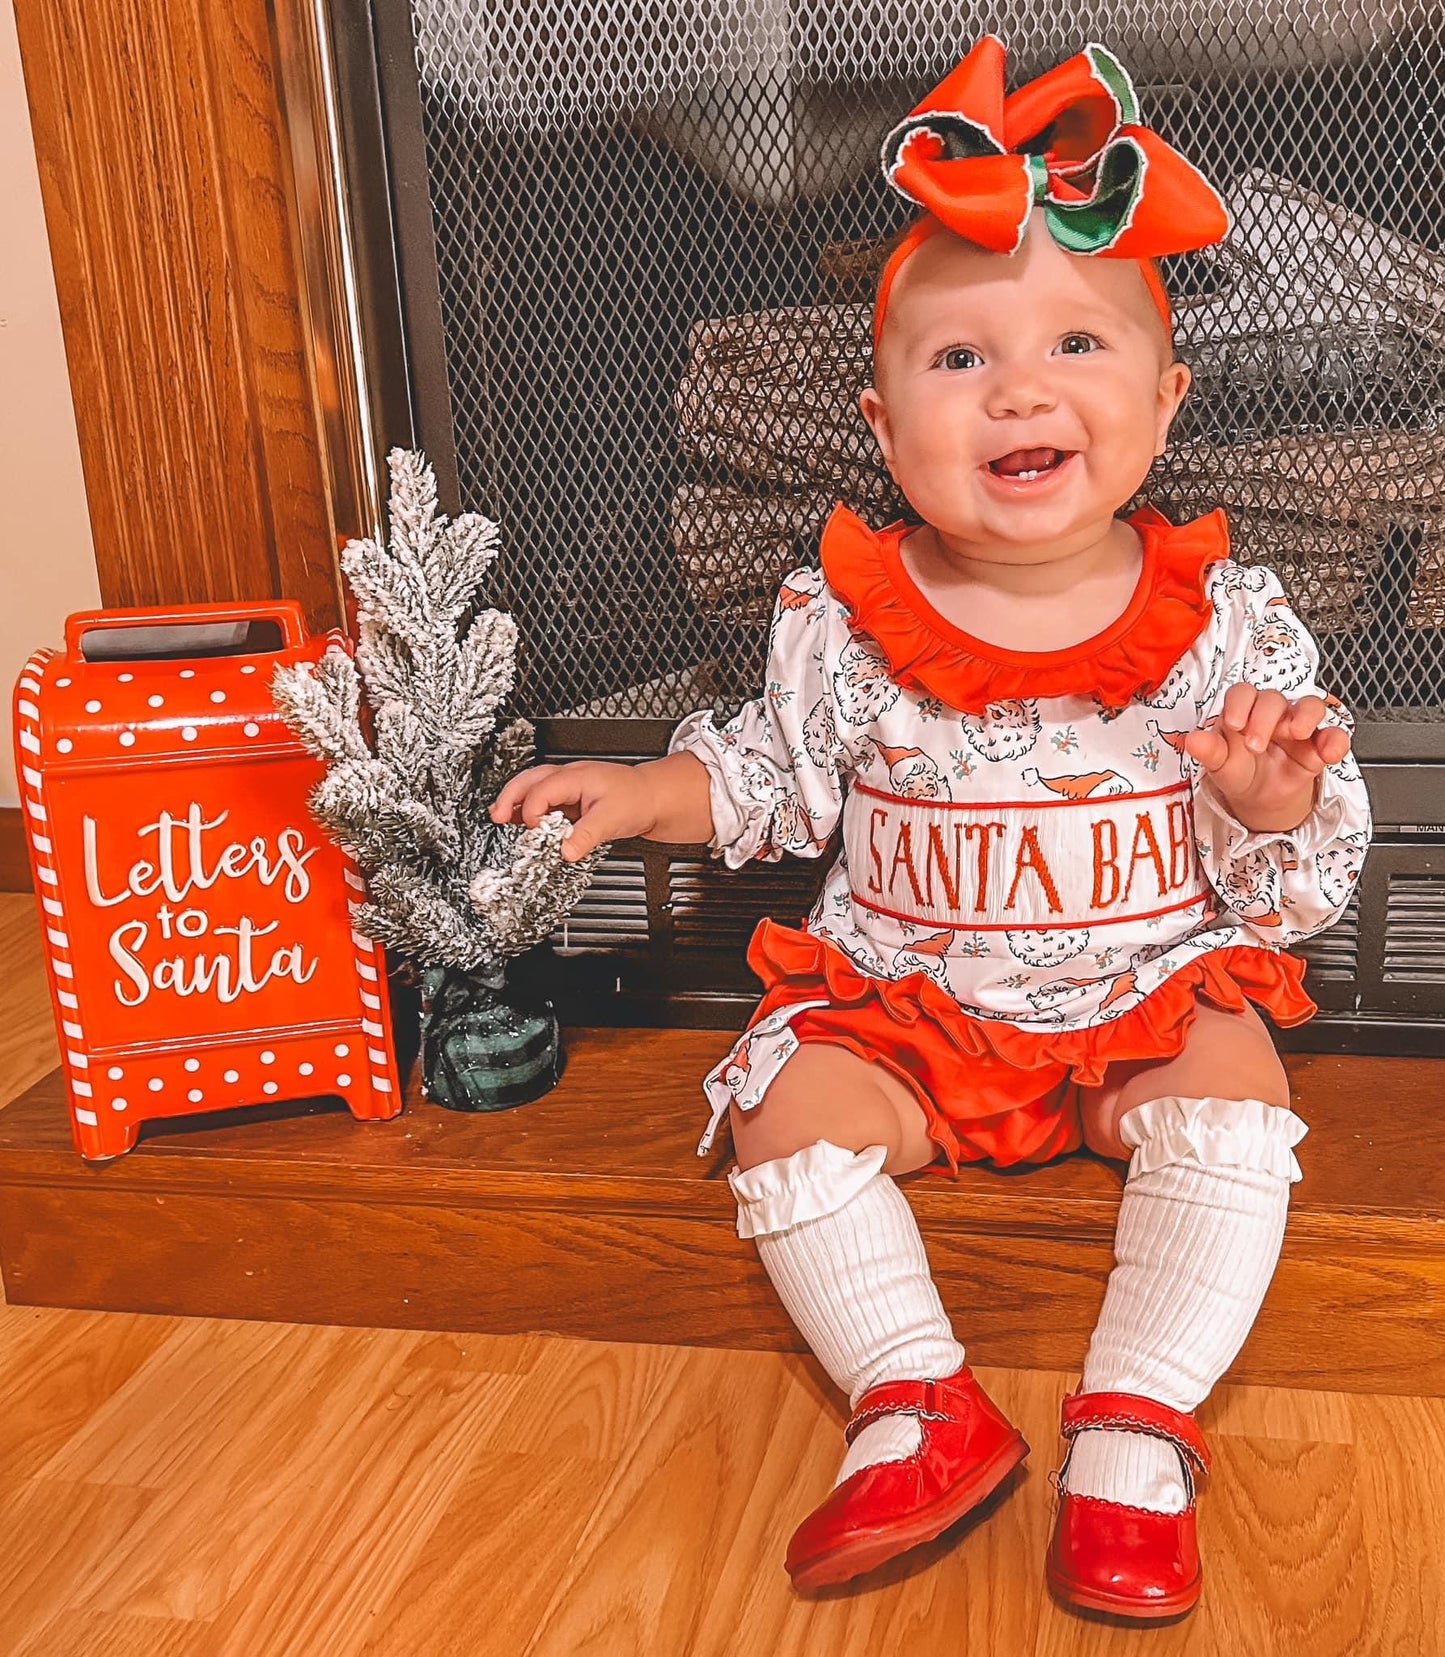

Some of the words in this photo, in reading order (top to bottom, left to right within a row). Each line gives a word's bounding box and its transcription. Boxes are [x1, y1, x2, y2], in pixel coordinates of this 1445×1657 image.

[83, 801, 320, 907] Letters
[868, 808, 1063, 913] SANTA
[108, 915, 319, 1007] Santa
[156, 903, 208, 939] to
